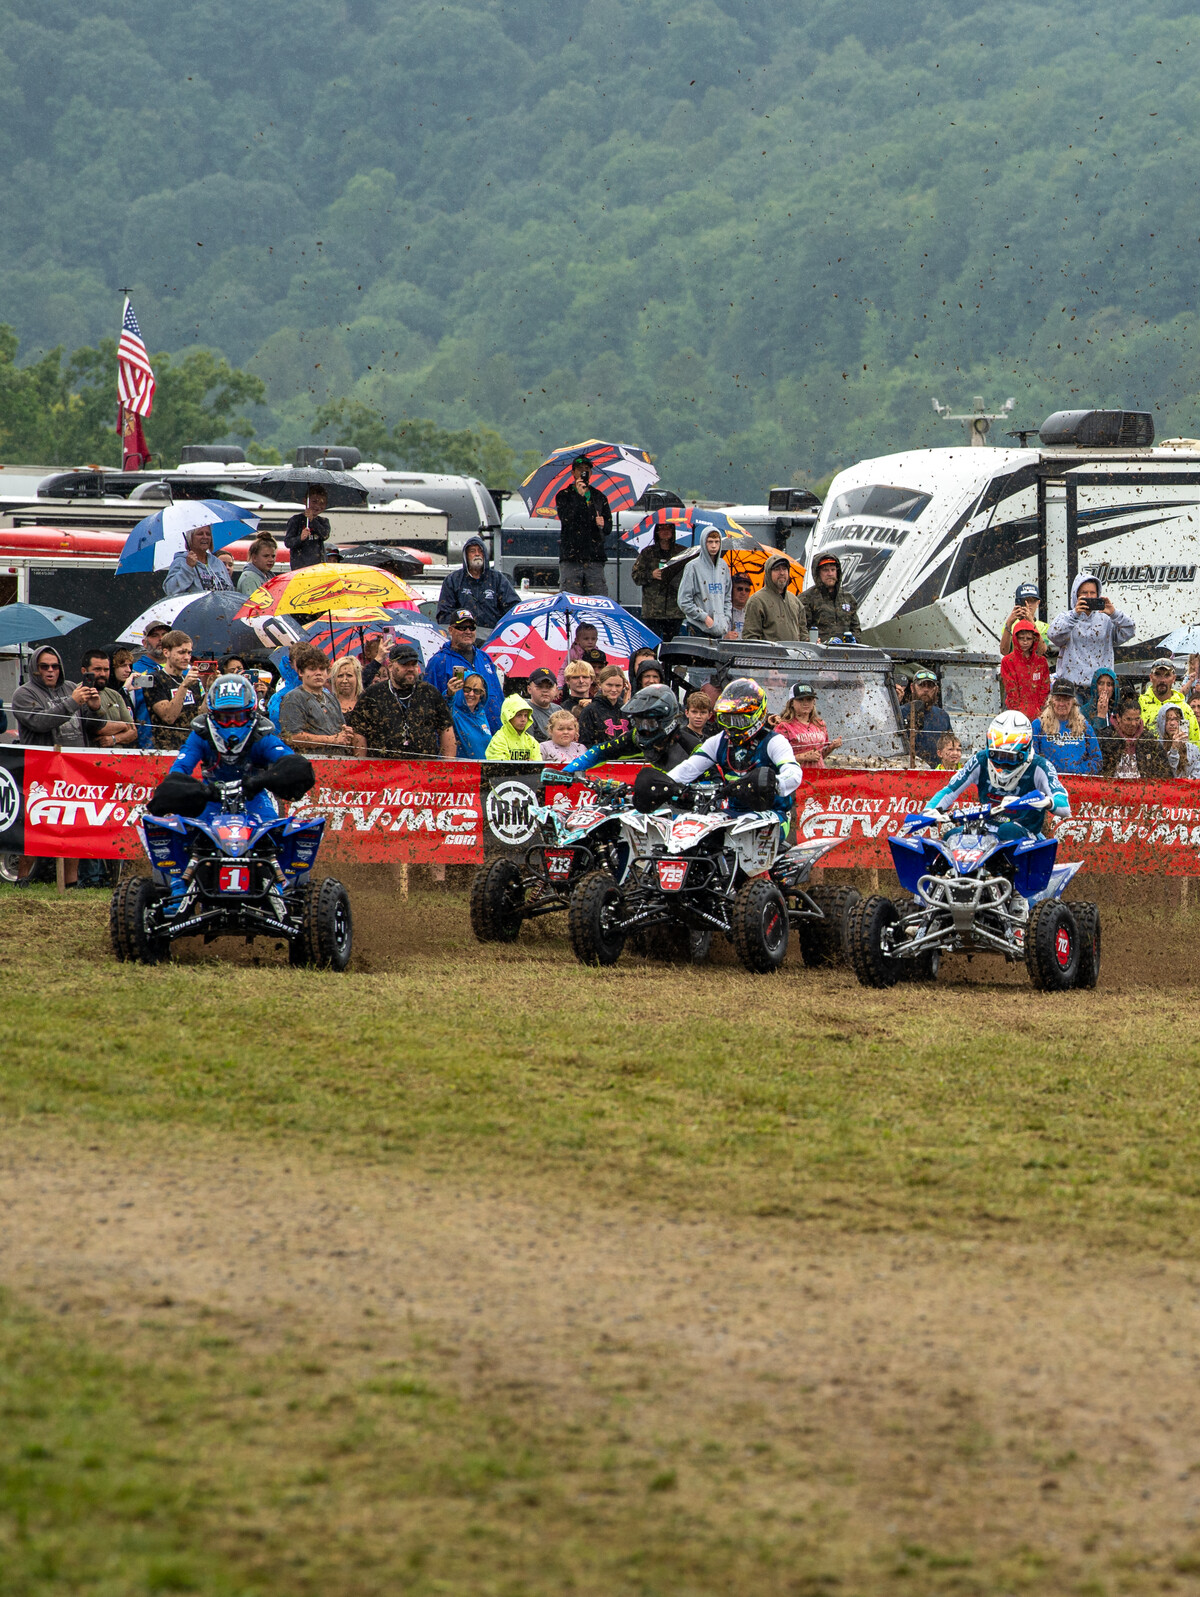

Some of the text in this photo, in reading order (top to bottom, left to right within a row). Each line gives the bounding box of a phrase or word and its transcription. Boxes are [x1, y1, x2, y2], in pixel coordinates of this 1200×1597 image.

[219, 682, 243, 693] FLY
[51, 780, 109, 801] ROCKY
[318, 787, 476, 807] ROCKY MOUNTAIN
[826, 795, 885, 814] ROCKY
[956, 850, 980, 861] 712
[226, 868, 242, 890] 1
[660, 868, 684, 883] 733
[1057, 937, 1068, 954] 712
